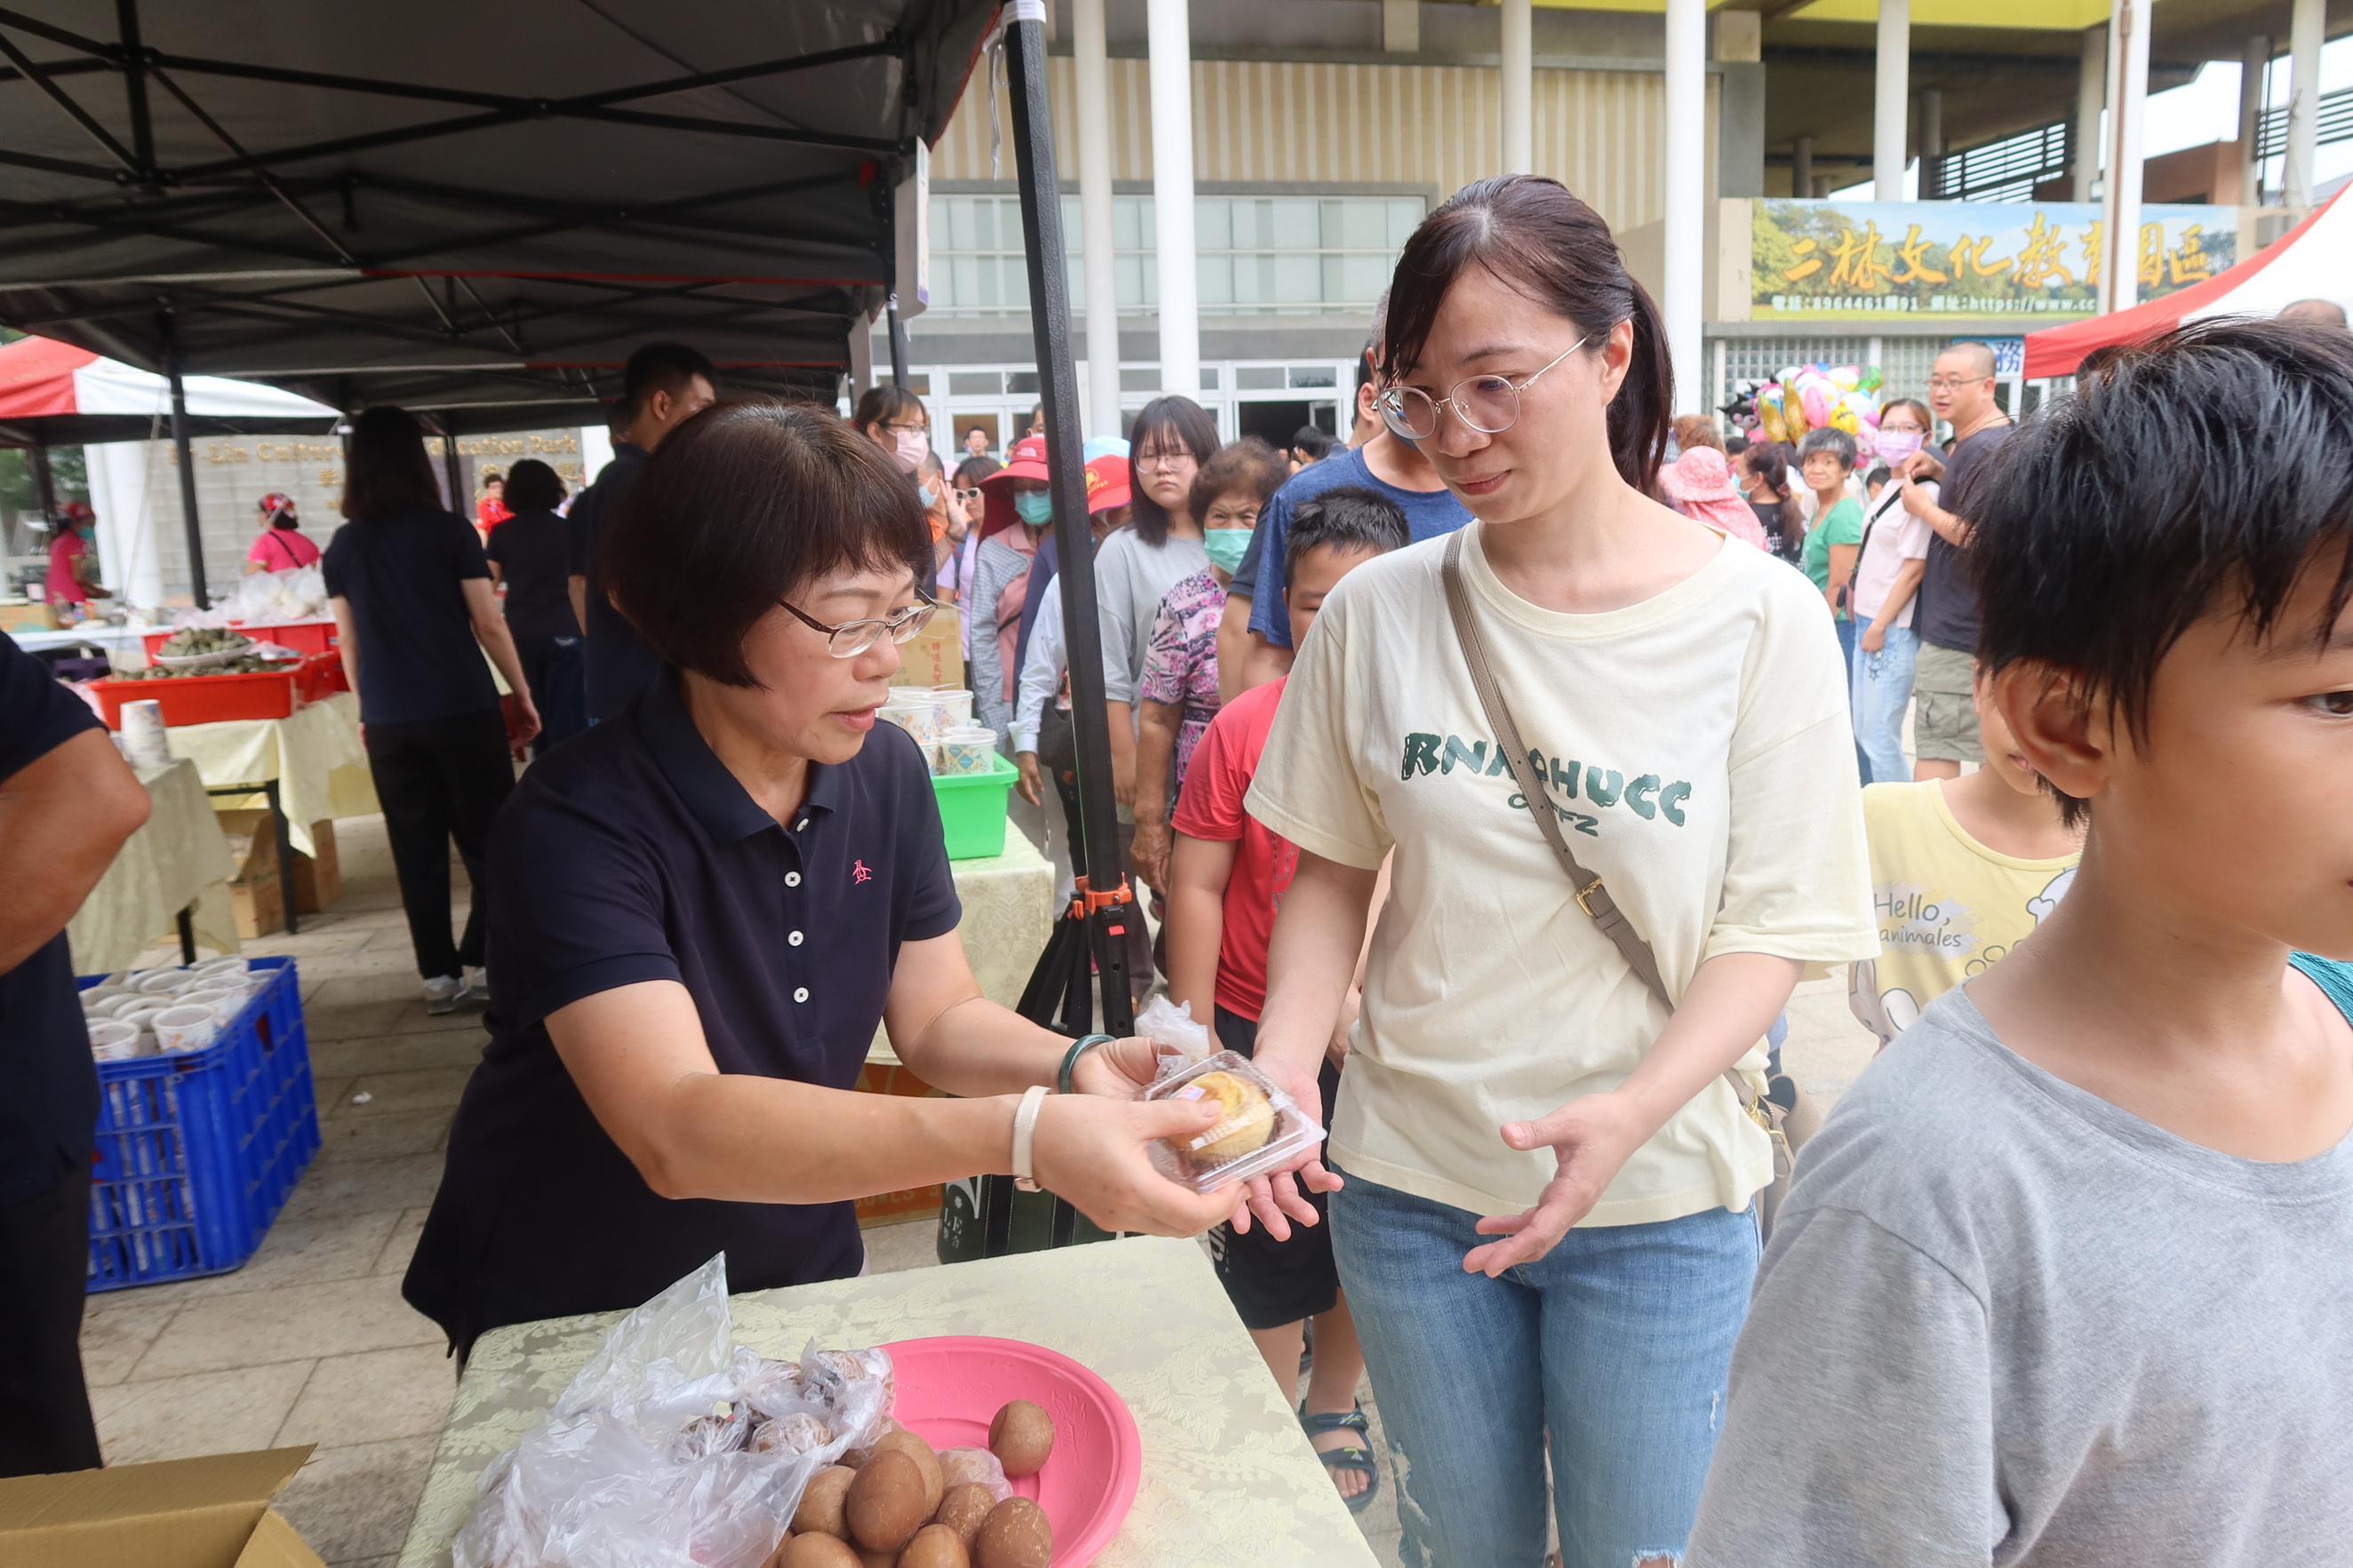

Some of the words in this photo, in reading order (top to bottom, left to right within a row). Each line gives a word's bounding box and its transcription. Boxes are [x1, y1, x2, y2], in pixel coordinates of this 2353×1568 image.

[167, 444, 248, 464] E-Lin
[530, 434, 578, 455] Park
[1874, 893, 1950, 926] Hello,
[1879, 926, 1962, 947] animales
